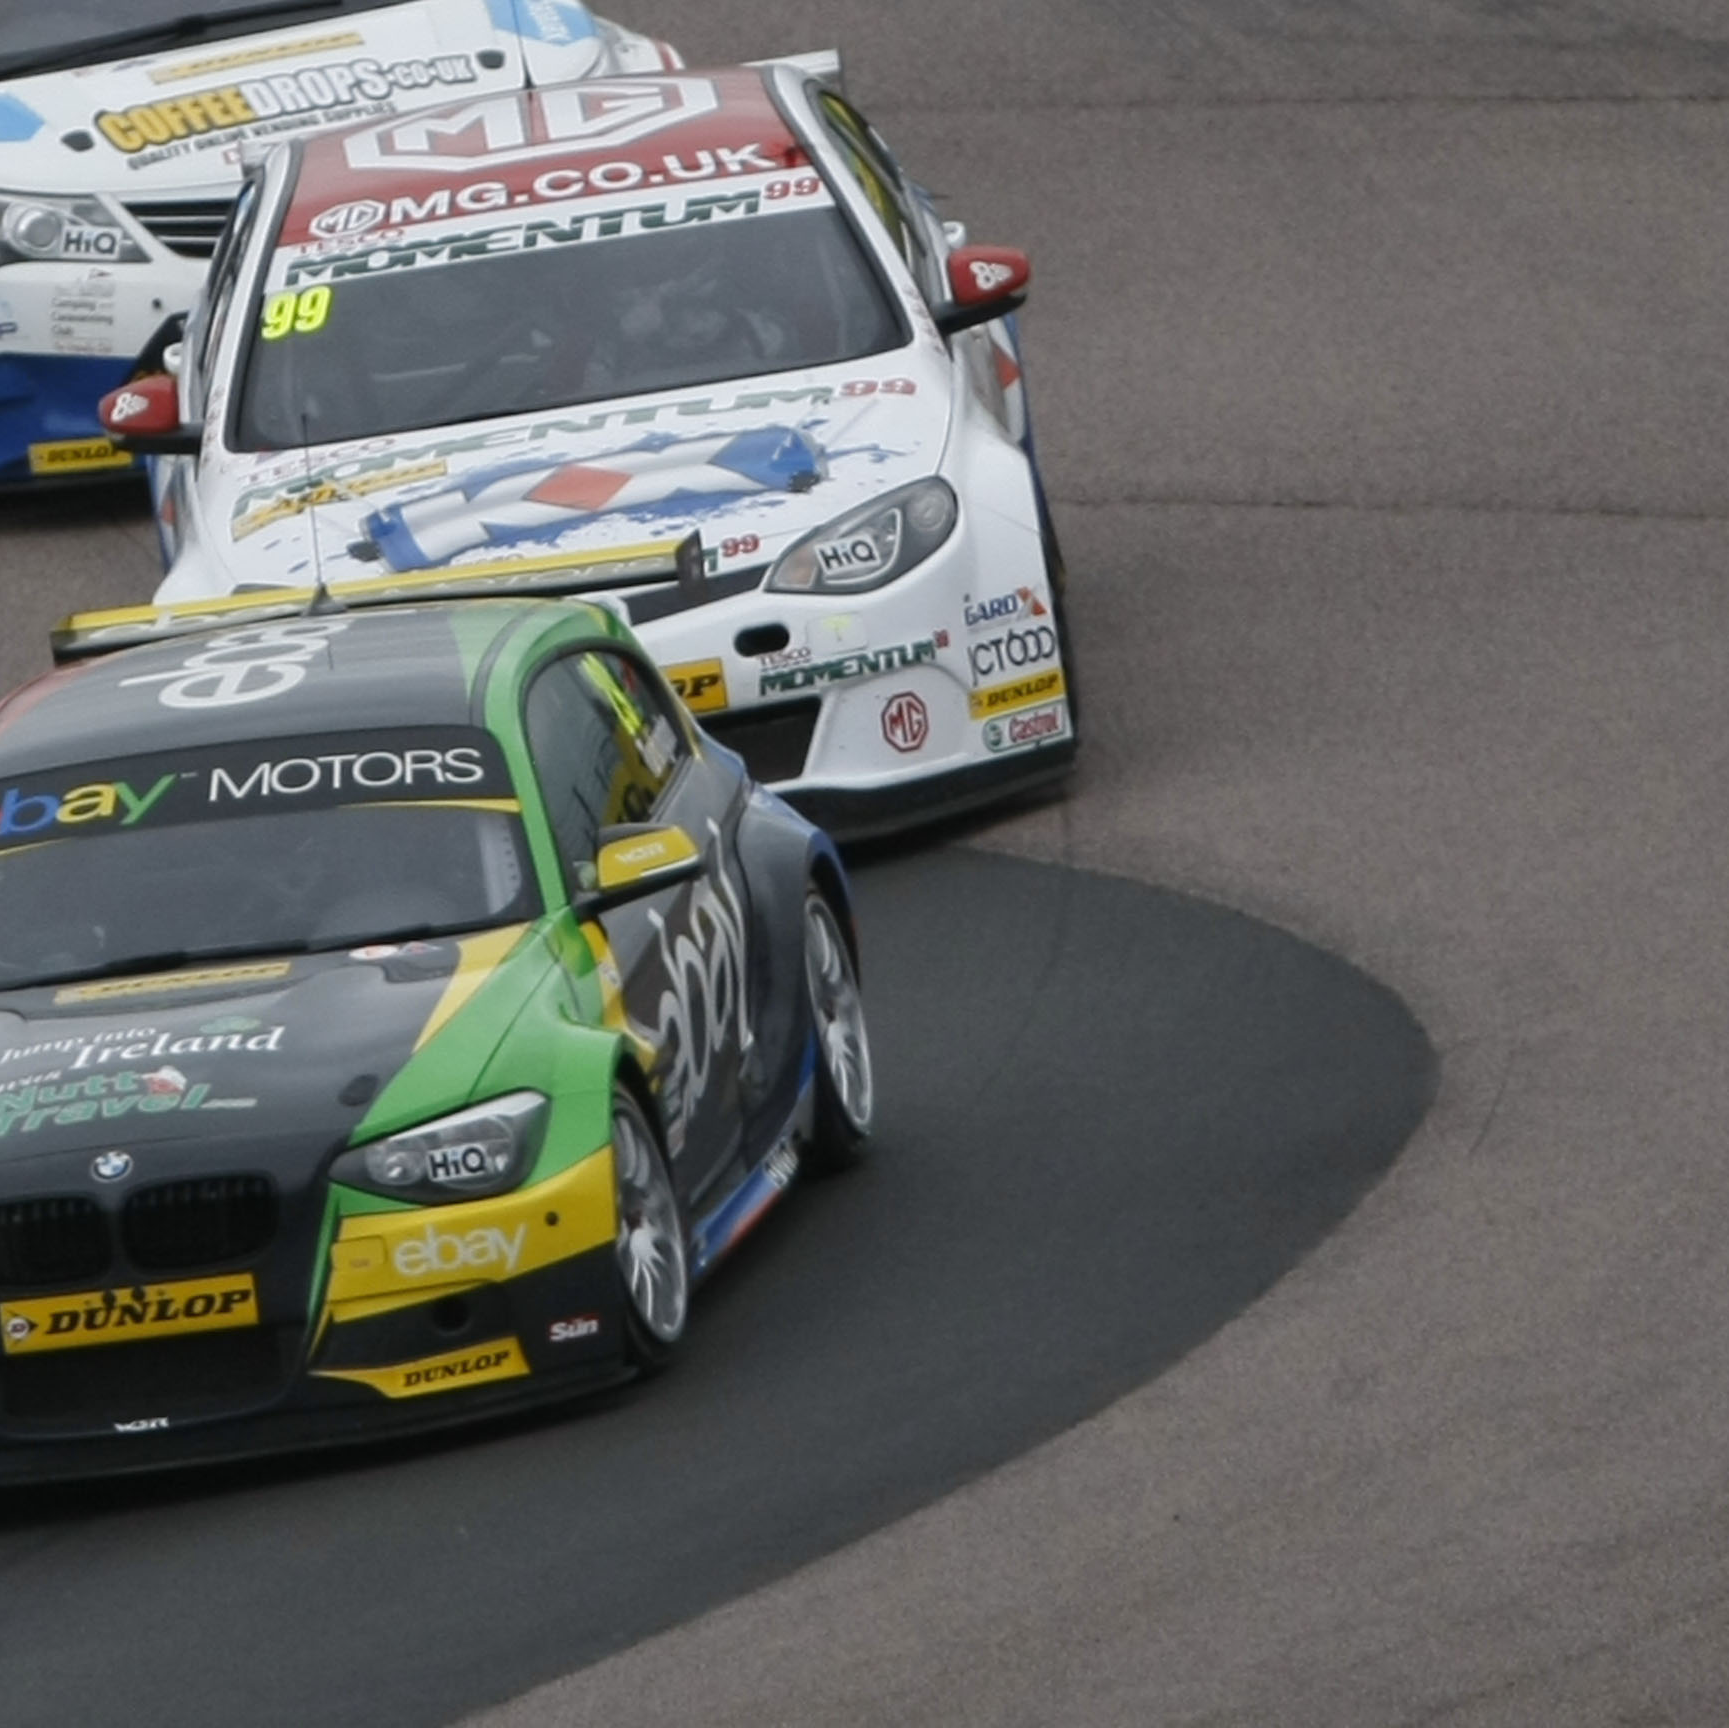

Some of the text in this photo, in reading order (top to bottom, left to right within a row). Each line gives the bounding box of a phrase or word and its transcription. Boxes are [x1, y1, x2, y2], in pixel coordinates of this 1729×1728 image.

[389, 84, 671, 156] MG
[390, 142, 776, 223] MG.CO.UK
[763, 175, 821, 201] 99
[62, 230, 117, 256] HiQ
[286, 187, 762, 287] MOMENTUM
[300, 228, 405, 255] TESCO
[260, 285, 332, 340] 99
[837, 378, 917, 397] 99
[720, 532, 761, 559] 99
[818, 539, 878, 572] HiQ
[758, 646, 812, 667] TESCO
[760, 638, 936, 696] MOMENTUM
[967, 626, 1057, 688] JCT600
[986, 672, 1059, 708] DUNLOP
[885, 700, 925, 744] MG
[1009, 706, 1060, 743] Castrol
[208, 748, 484, 803] MOTORS
[68, 1025, 287, 1071] Ireland
[93, 1026, 157, 1045] into
[427, 1147, 487, 1179] HiQ
[393, 1222, 527, 1278] ebay
[44, 1287, 253, 1336] DUNLOP
[402, 1349, 511, 1389] DUNLOP
